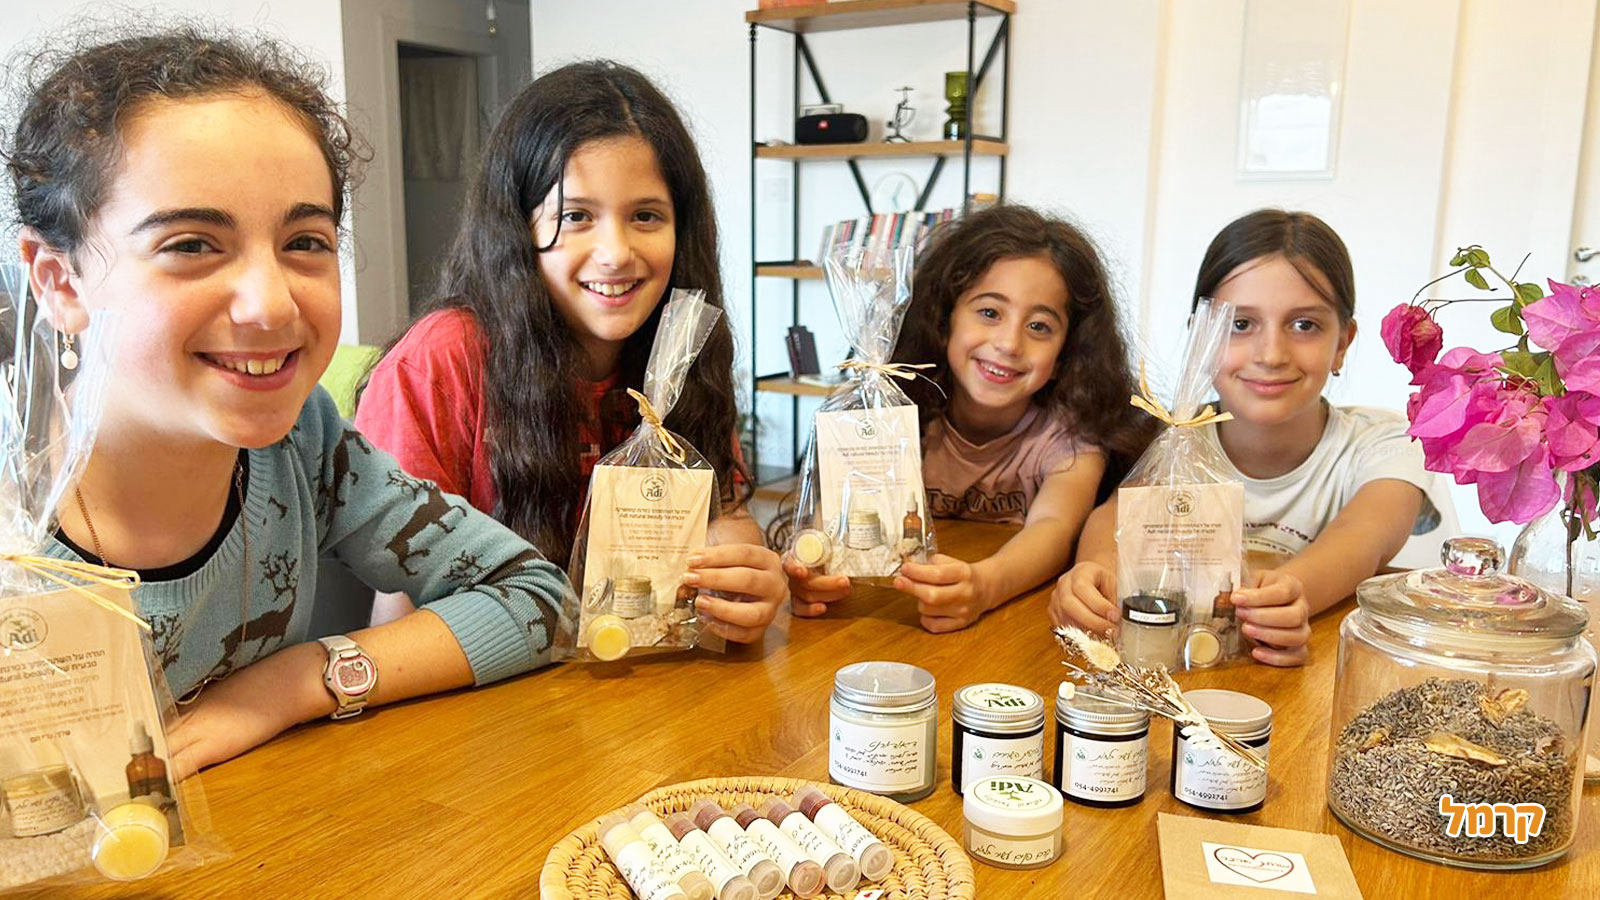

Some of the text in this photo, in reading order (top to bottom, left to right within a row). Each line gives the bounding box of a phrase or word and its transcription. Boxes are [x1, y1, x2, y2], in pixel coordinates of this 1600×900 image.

[646, 488, 662, 498] Adi
[1174, 505, 1190, 514] Adi
[8, 629, 40, 646] Adi
[23, 668, 56, 680] beauty
[984, 698, 1026, 707] Adi
[990, 782, 1034, 794] Adi
[1075, 782, 1118, 794] 054-4992741
[1184, 786, 1228, 801] 054-4992741
